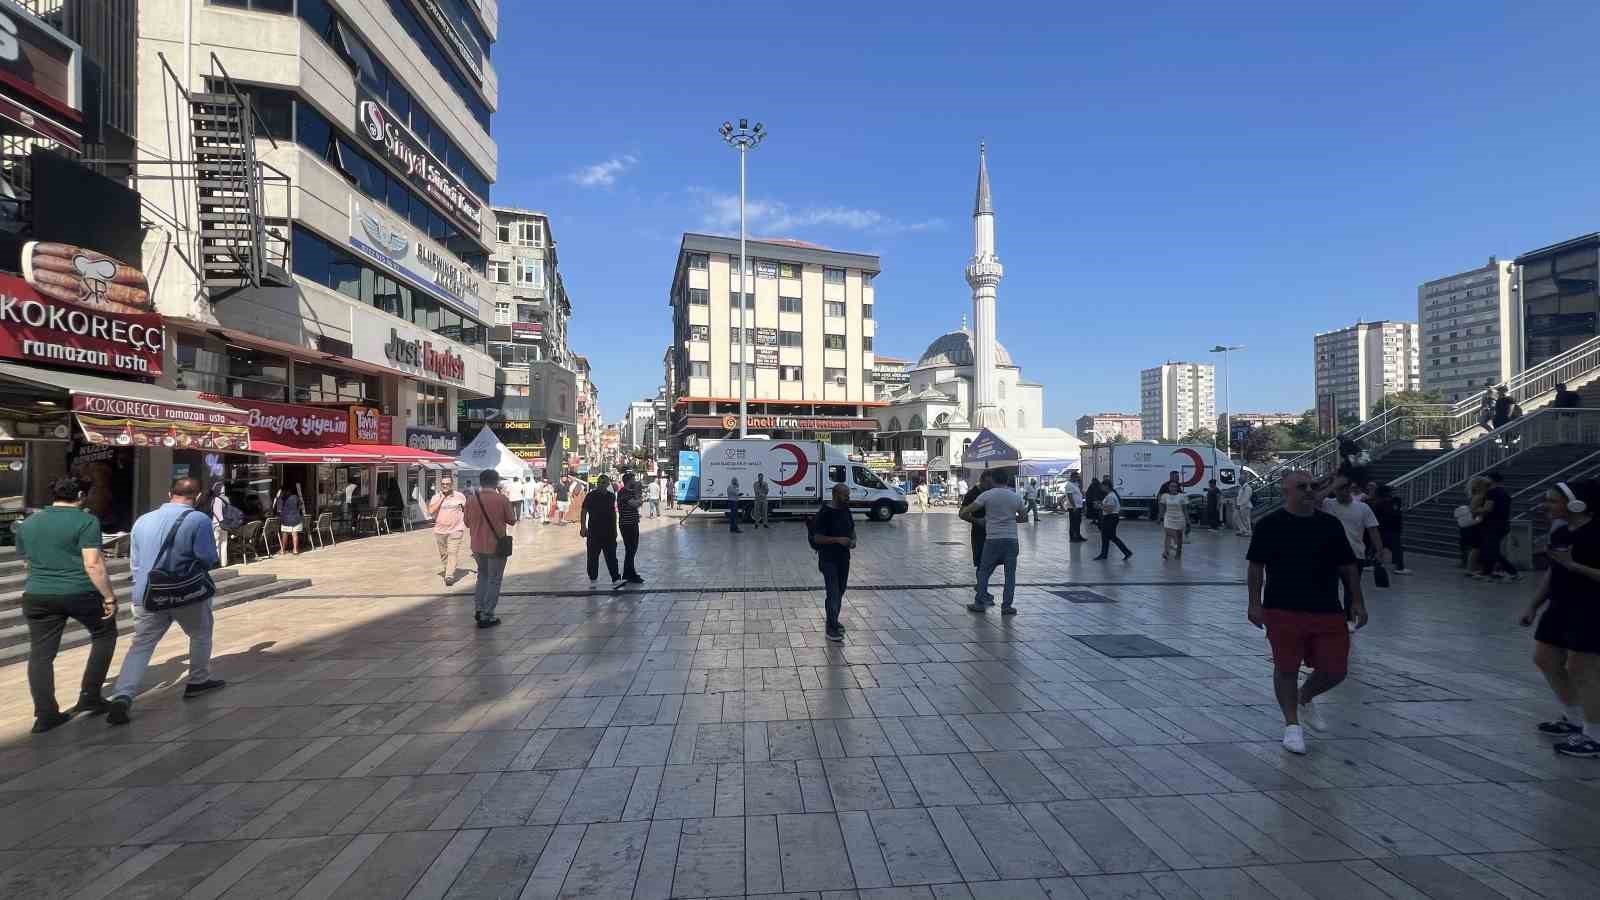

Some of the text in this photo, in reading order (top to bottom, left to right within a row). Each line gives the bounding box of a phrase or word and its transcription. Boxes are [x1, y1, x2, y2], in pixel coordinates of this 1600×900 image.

[23, 338, 148, 372] ramazan usta
[423, 340, 465, 381] English
[165, 408, 205, 422] ramazan
[209, 414, 226, 423] usta
[247, 408, 347, 436] Burger yiyelim
